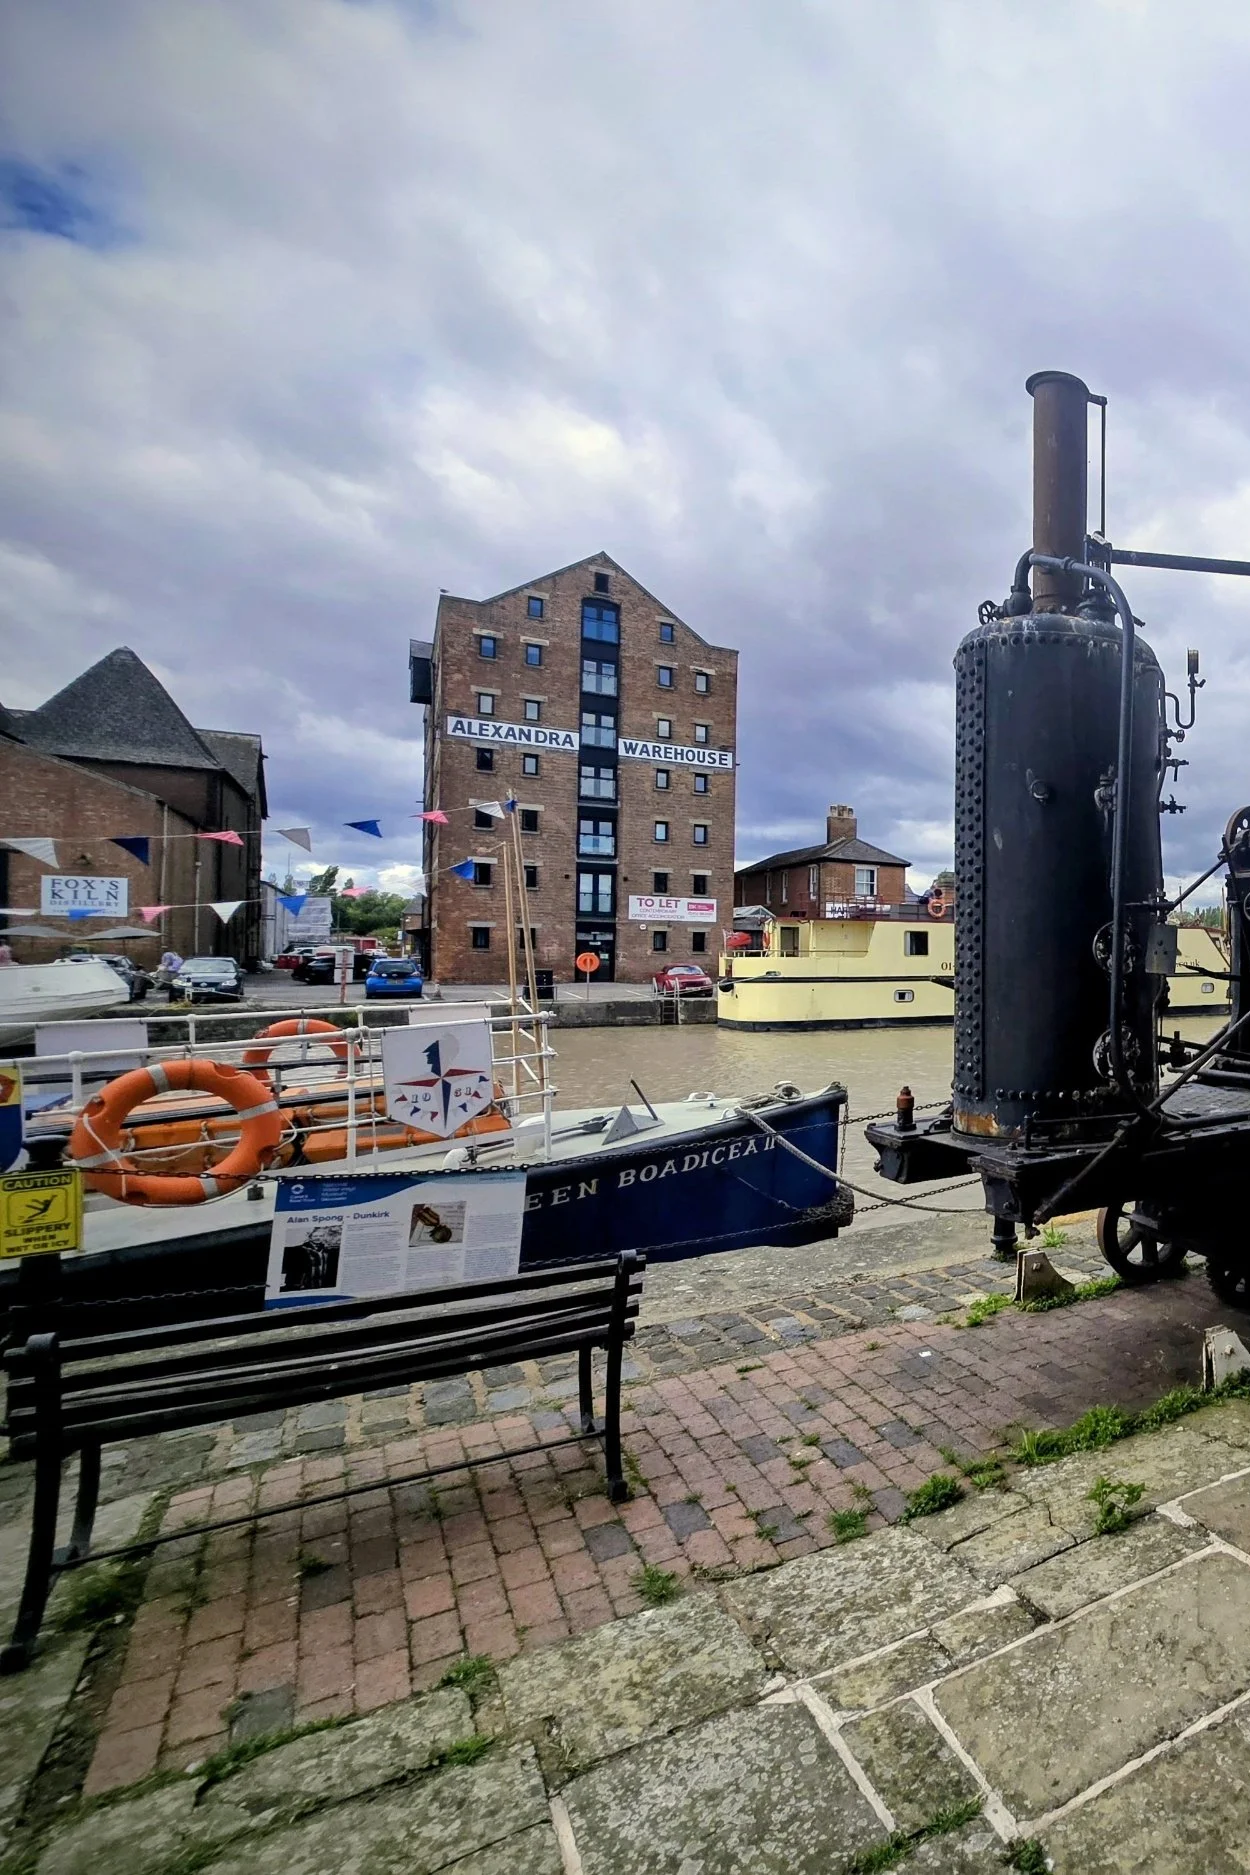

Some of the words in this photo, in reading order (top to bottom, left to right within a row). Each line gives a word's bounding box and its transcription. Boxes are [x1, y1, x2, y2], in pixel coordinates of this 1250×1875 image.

[451, 719, 575, 748] ALEXANDRA
[622, 741, 729, 766] WAREHOUSE
[51, 878, 120, 890] FOX'S
[51, 889, 120, 900] KILN
[50, 899, 120, 907] DISTILLERY
[636, 897, 655, 907] TO
[658, 898, 681, 909] LET
[617, 1138, 760, 1188] BOADICEA
[4, 1175, 71, 1190] CAUTION
[287, 1216, 309, 1224] Alan
[312, 1214, 344, 1223] Spong
[353, 1210, 390, 1220] Dunkirk
[4, 1222, 71, 1238] SLIPPERY
[22, 1234, 57, 1243] WHEN
[6, 1244, 31, 1253] WET
[32, 1242, 49, 1250] OR
[52, 1240, 70, 1248] ICY
